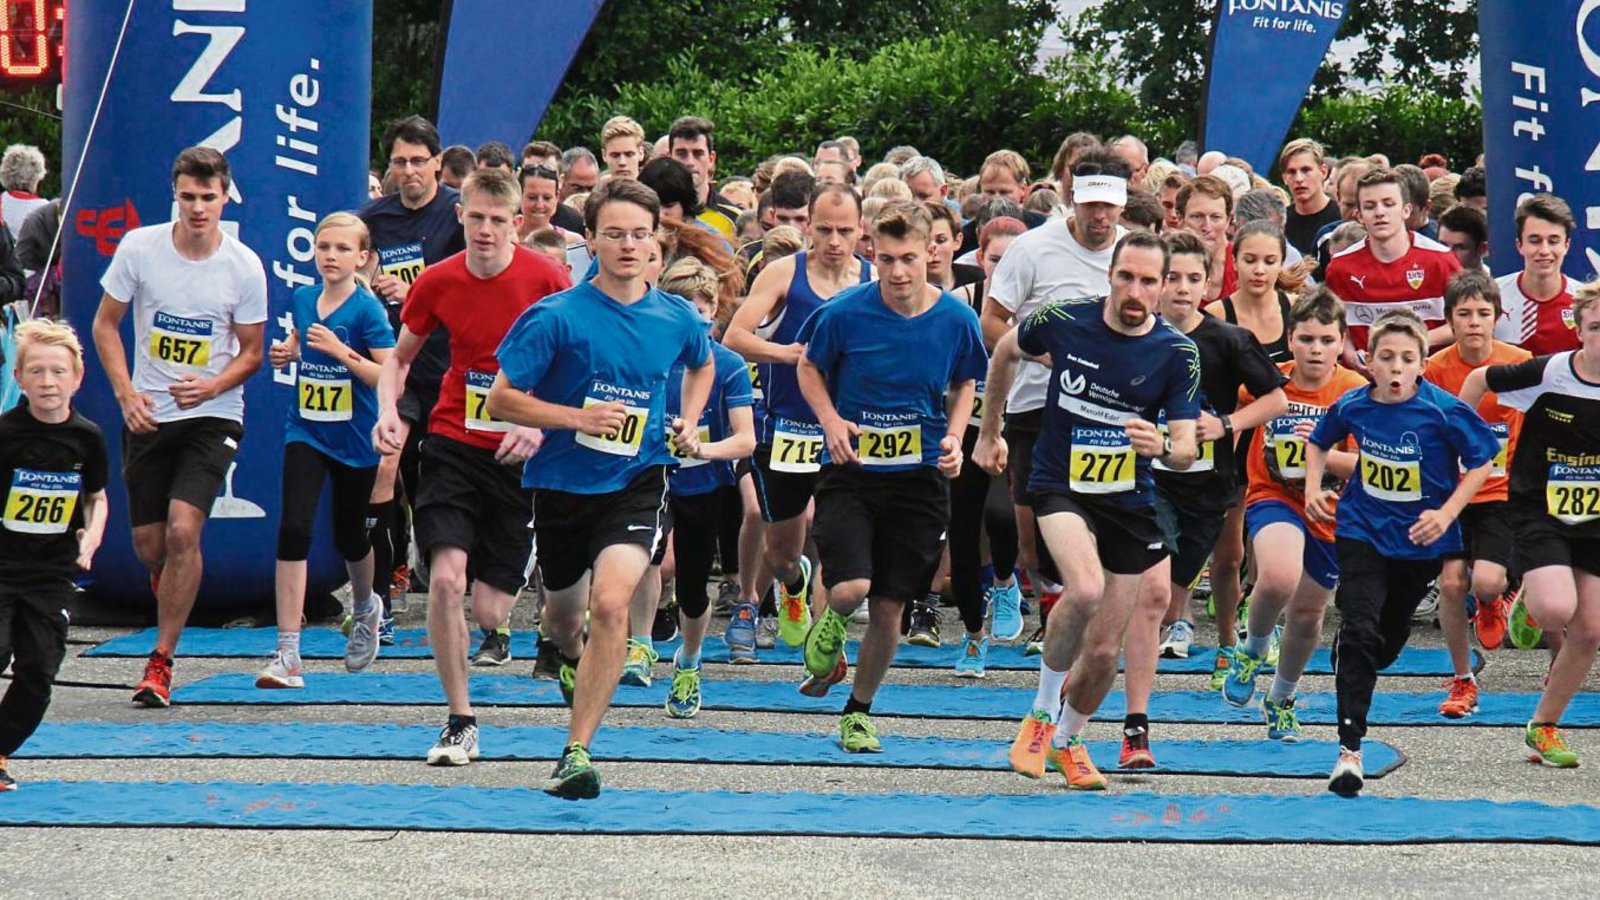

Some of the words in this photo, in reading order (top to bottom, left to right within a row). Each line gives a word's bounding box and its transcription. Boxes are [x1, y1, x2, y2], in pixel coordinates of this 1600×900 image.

[1229, 0, 1343, 19] FONTANIS
[1253, 16, 1269, 28] Fit
[1272, 17, 1291, 29] for
[1293, 19, 1317, 34] life.
[1511, 61, 1549, 141] Fit
[275, 58, 320, 175] life.
[273, 195, 317, 288] for
[158, 313, 210, 329] FONTANIS
[158, 335, 202, 365] 657
[304, 384, 343, 412] 217
[593, 382, 651, 400] FONTANIS
[1090, 382, 1120, 399] Deutsche
[862, 411, 918, 421] FONTANIS
[868, 431, 913, 458] 292
[19, 470, 80, 484] FONTANIS
[1080, 453, 1128, 483] 277
[1367, 461, 1412, 492] 202
[15, 494, 66, 523] 266
[1556, 487, 1600, 516] 282
